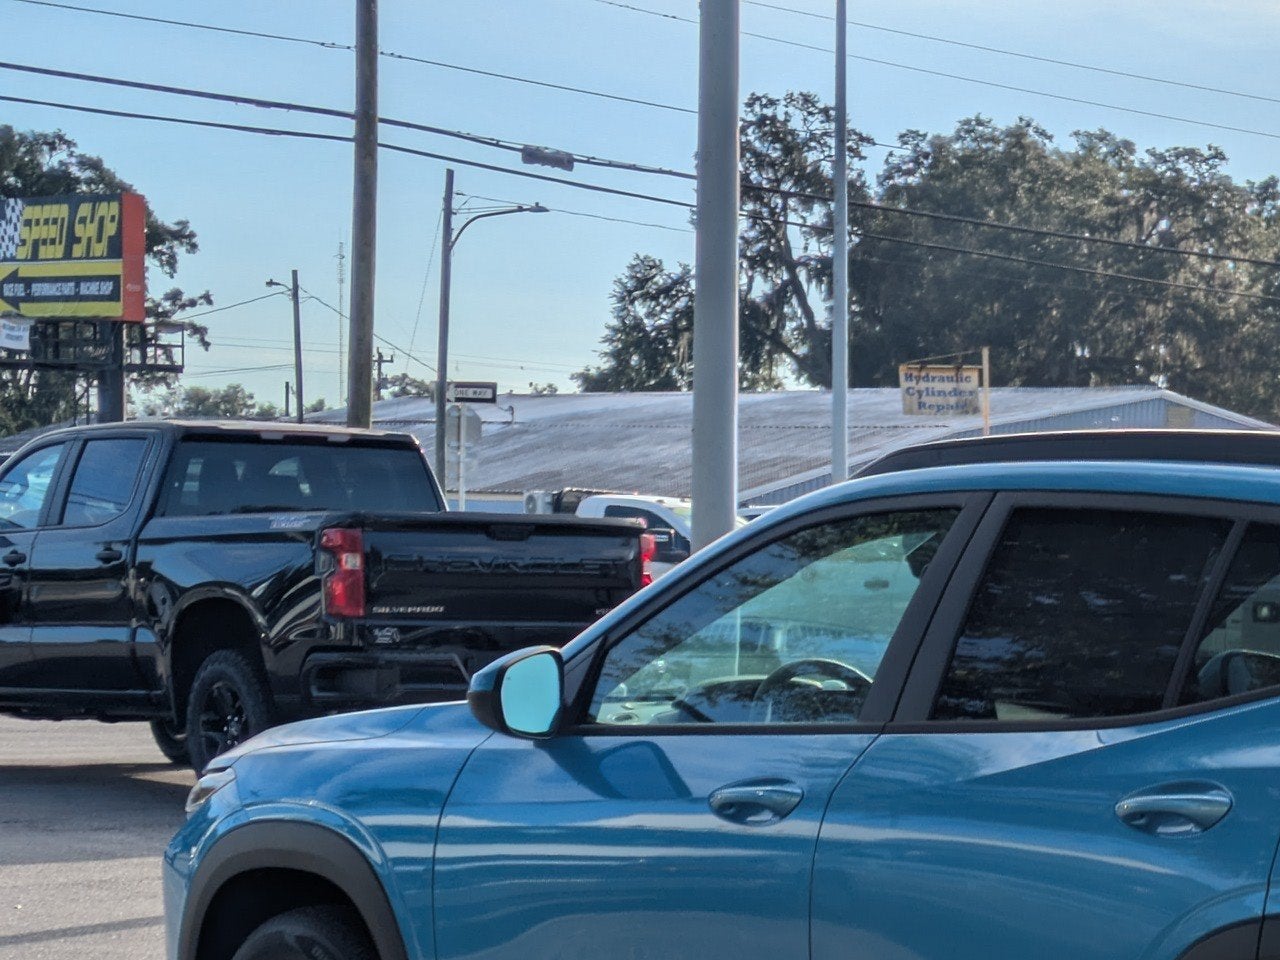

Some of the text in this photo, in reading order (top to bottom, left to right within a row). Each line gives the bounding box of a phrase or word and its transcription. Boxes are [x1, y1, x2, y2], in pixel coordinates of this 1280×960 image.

[16, 201, 119, 260] SPEED SHOP
[904, 372, 972, 385] Hydraulic
[454, 388, 469, 396] ONE
[905, 386, 976, 399] Cylinder
[371, 605, 445, 614] SILVERADO
